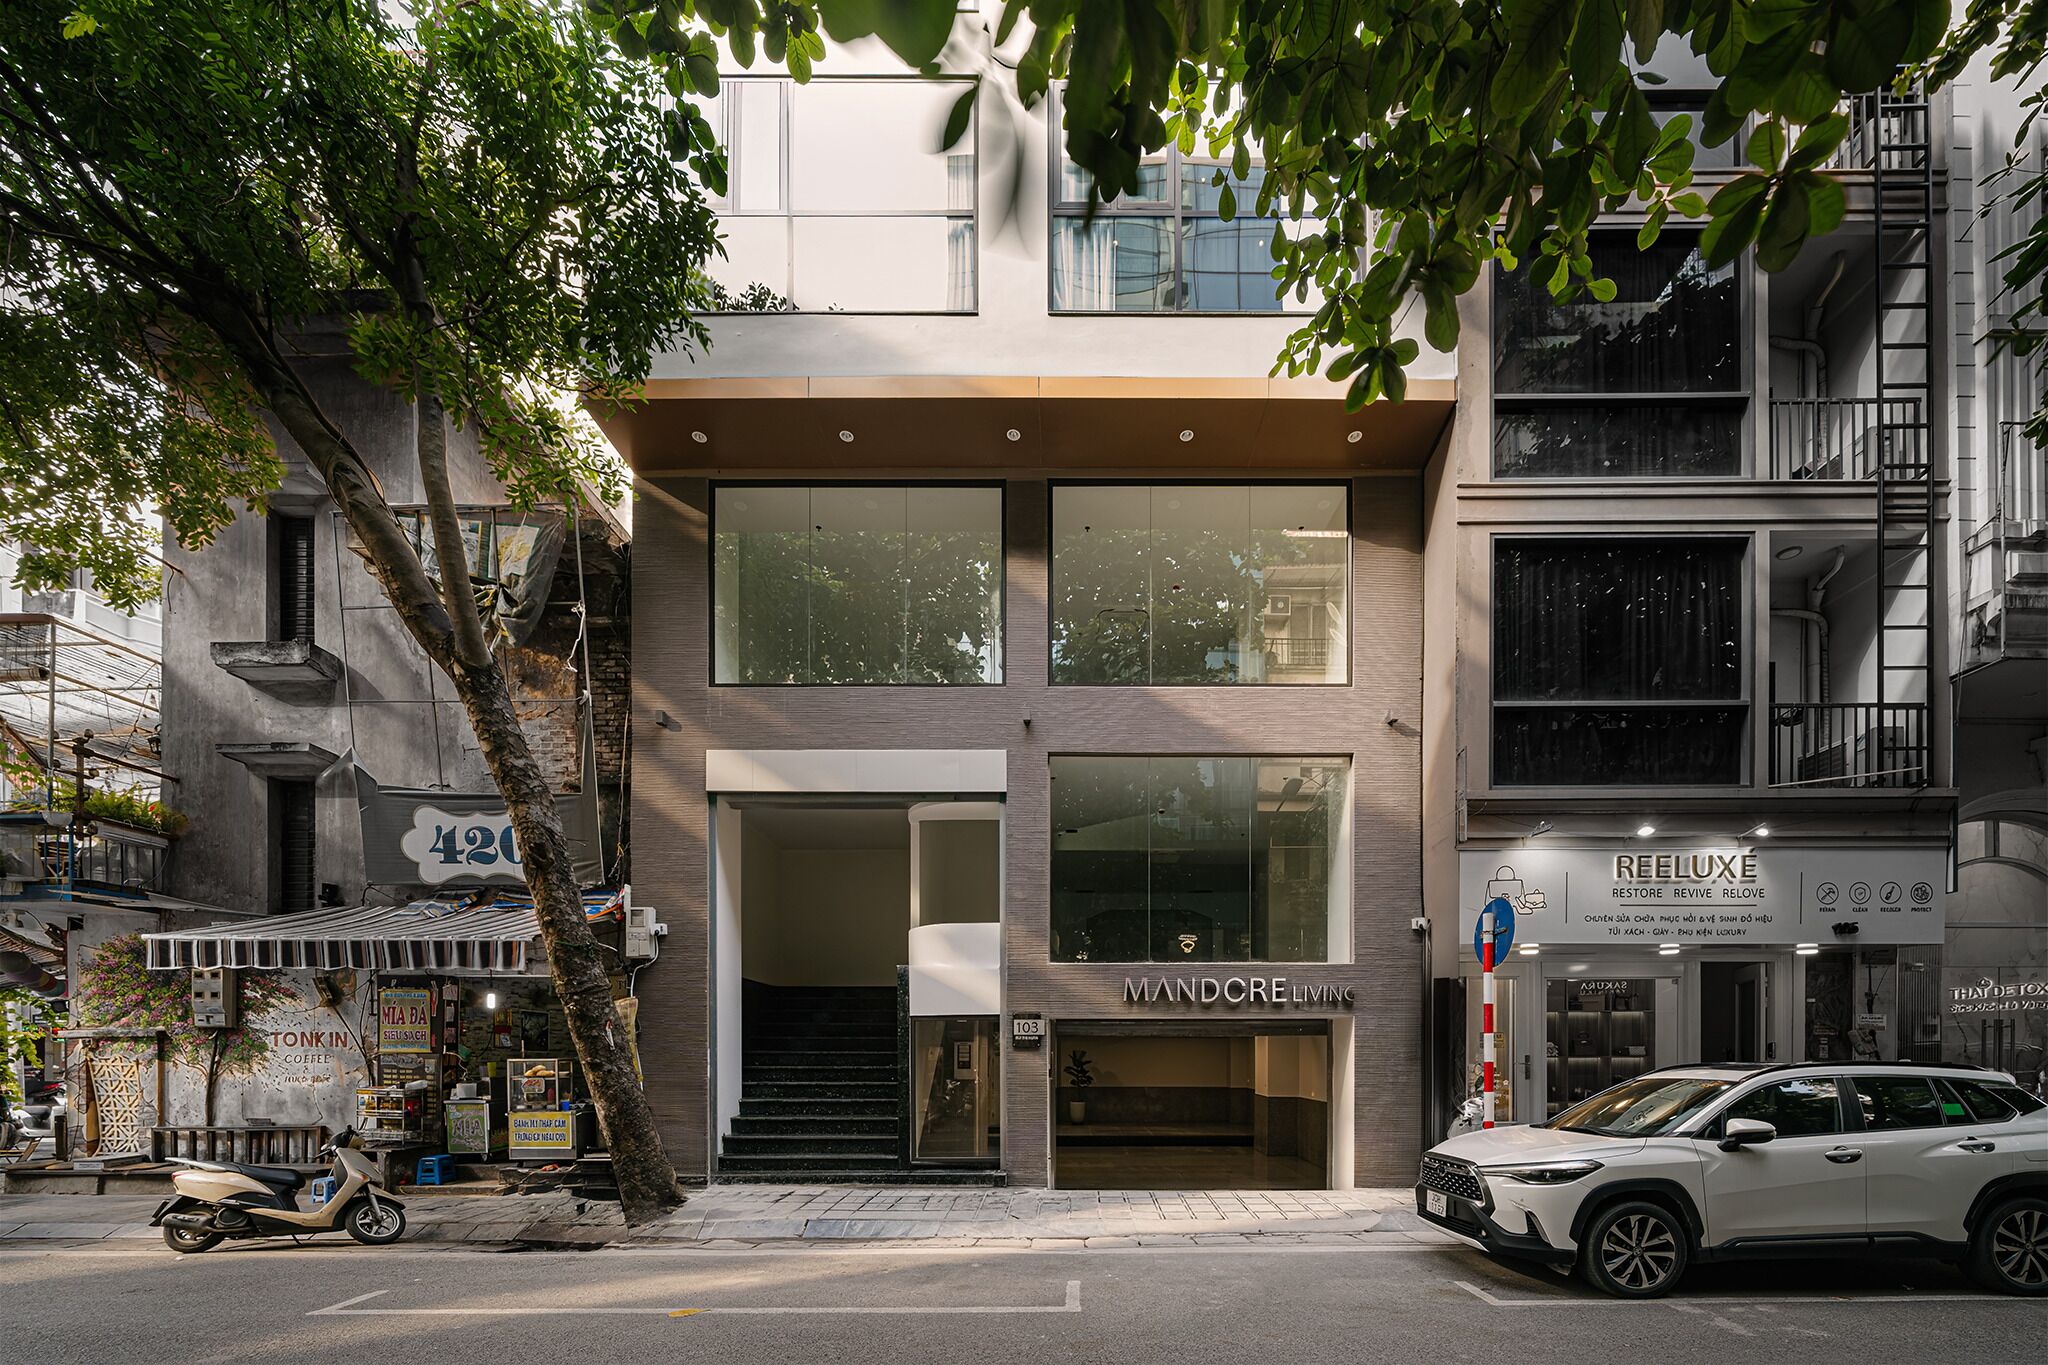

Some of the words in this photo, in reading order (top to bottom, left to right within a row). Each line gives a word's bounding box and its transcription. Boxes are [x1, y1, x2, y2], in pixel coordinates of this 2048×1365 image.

[1615, 847, 1757, 879] REELUXÉ
[1612, 887, 1662, 898] RESTORE
[1674, 887, 1712, 898] REVIVE
[1722, 887, 1765, 898] RELOVE
[382, 1000, 406, 1025] MÍA
[409, 1001, 428, 1025] ĐÁ
[1017, 1022, 1038, 1033] 103
[270, 1031, 348, 1048] TONKIN
